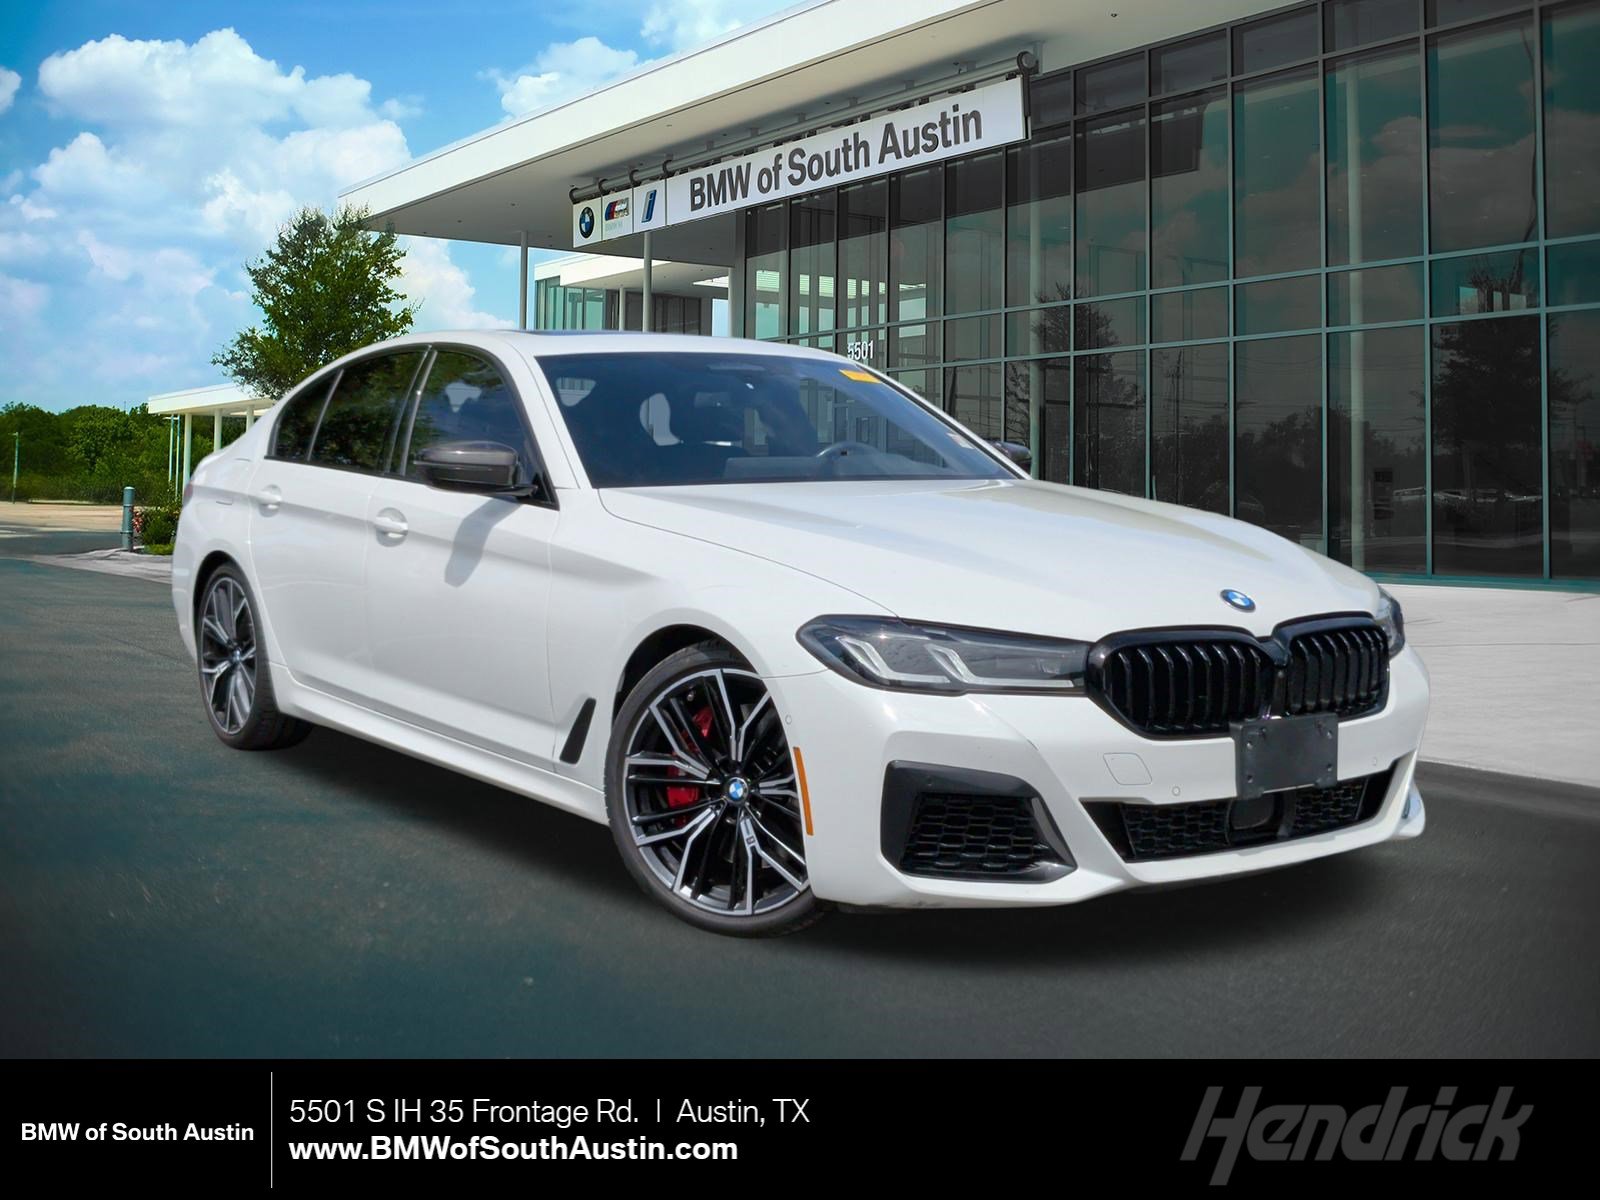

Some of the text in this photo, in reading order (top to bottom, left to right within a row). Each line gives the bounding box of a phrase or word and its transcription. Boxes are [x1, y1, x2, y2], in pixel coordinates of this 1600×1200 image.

[689, 104, 983, 212] BMW of South Austin
[847, 340, 874, 360] 5501
